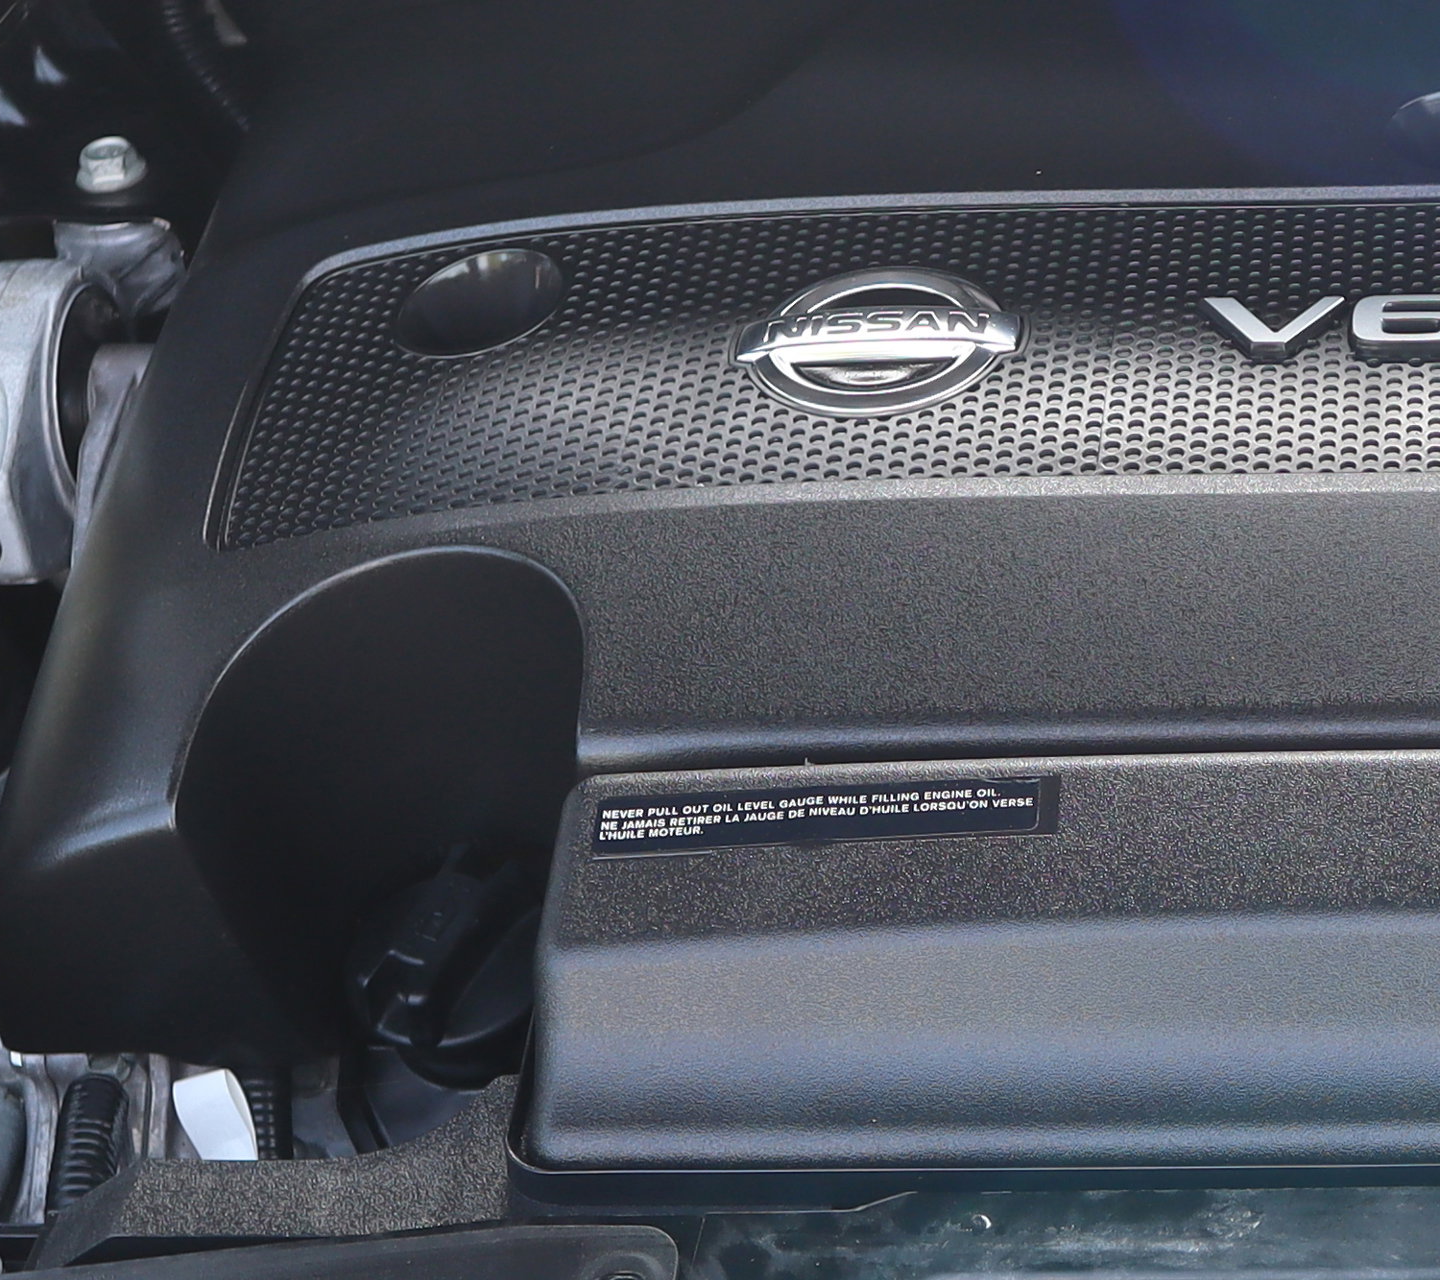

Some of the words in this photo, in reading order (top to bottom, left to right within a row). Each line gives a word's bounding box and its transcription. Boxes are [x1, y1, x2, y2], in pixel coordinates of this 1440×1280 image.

[762, 306, 991, 342] NISSAN
[600, 820, 618, 831] NE
[621, 818, 666, 830] JAMAIS
[669, 815, 722, 827] RETIRER
[725, 813, 740, 824] LA
[743, 811, 784, 822] JAUGE
[788, 808, 806, 819] DE
[808, 805, 856, 817] NIVEAU
[859, 803, 910, 815] D'HUILE
[913, 800, 988, 813] LORSQU'ON
[992, 797, 1034, 808] VERSE
[602, 808, 644, 820] NEVER
[647, 806, 678, 817] PULL
[682, 804, 709, 815] OUT
[712, 802, 733, 813] OIL
[737, 800, 775, 811] LEVEL
[779, 797, 824, 809] GAUGE
[827, 794, 867, 805] WHILE
[871, 791, 920, 804] FILLING
[923, 789, 973, 801] ENGINE
[976, 788, 1001, 798] OIL.
[599, 828, 645, 841] L'HUILE
[648, 825, 704, 839] MOTEUR.
